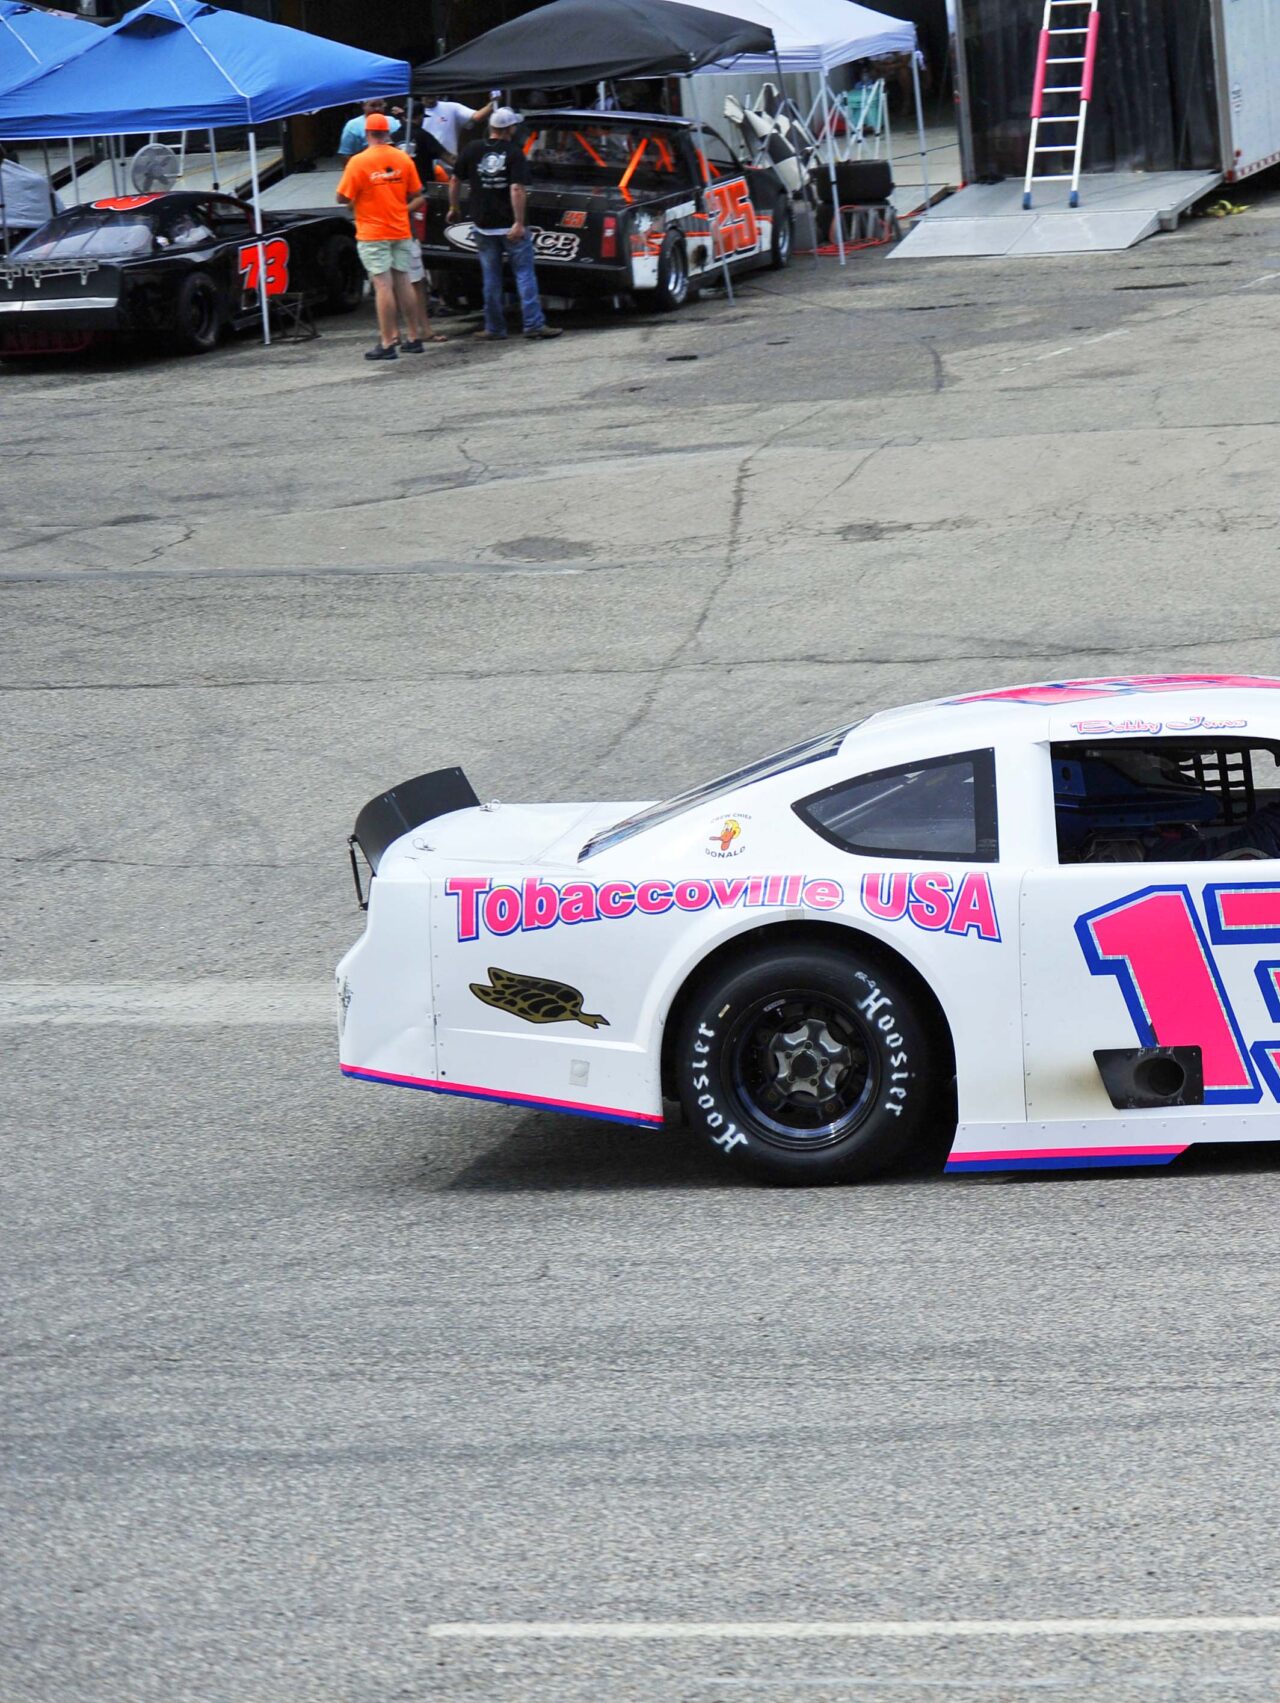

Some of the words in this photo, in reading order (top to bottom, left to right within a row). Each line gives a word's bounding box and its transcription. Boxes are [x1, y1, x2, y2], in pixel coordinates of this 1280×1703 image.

[704, 178, 757, 260] 25
[239, 238, 289, 297] 73
[705, 846, 746, 858] DONALD
[446, 875, 844, 943] Tobaccoville
[861, 871, 1003, 943] USA
[692, 1022, 749, 1153] Hoosier
[854, 987, 909, 1117] Hoosier
